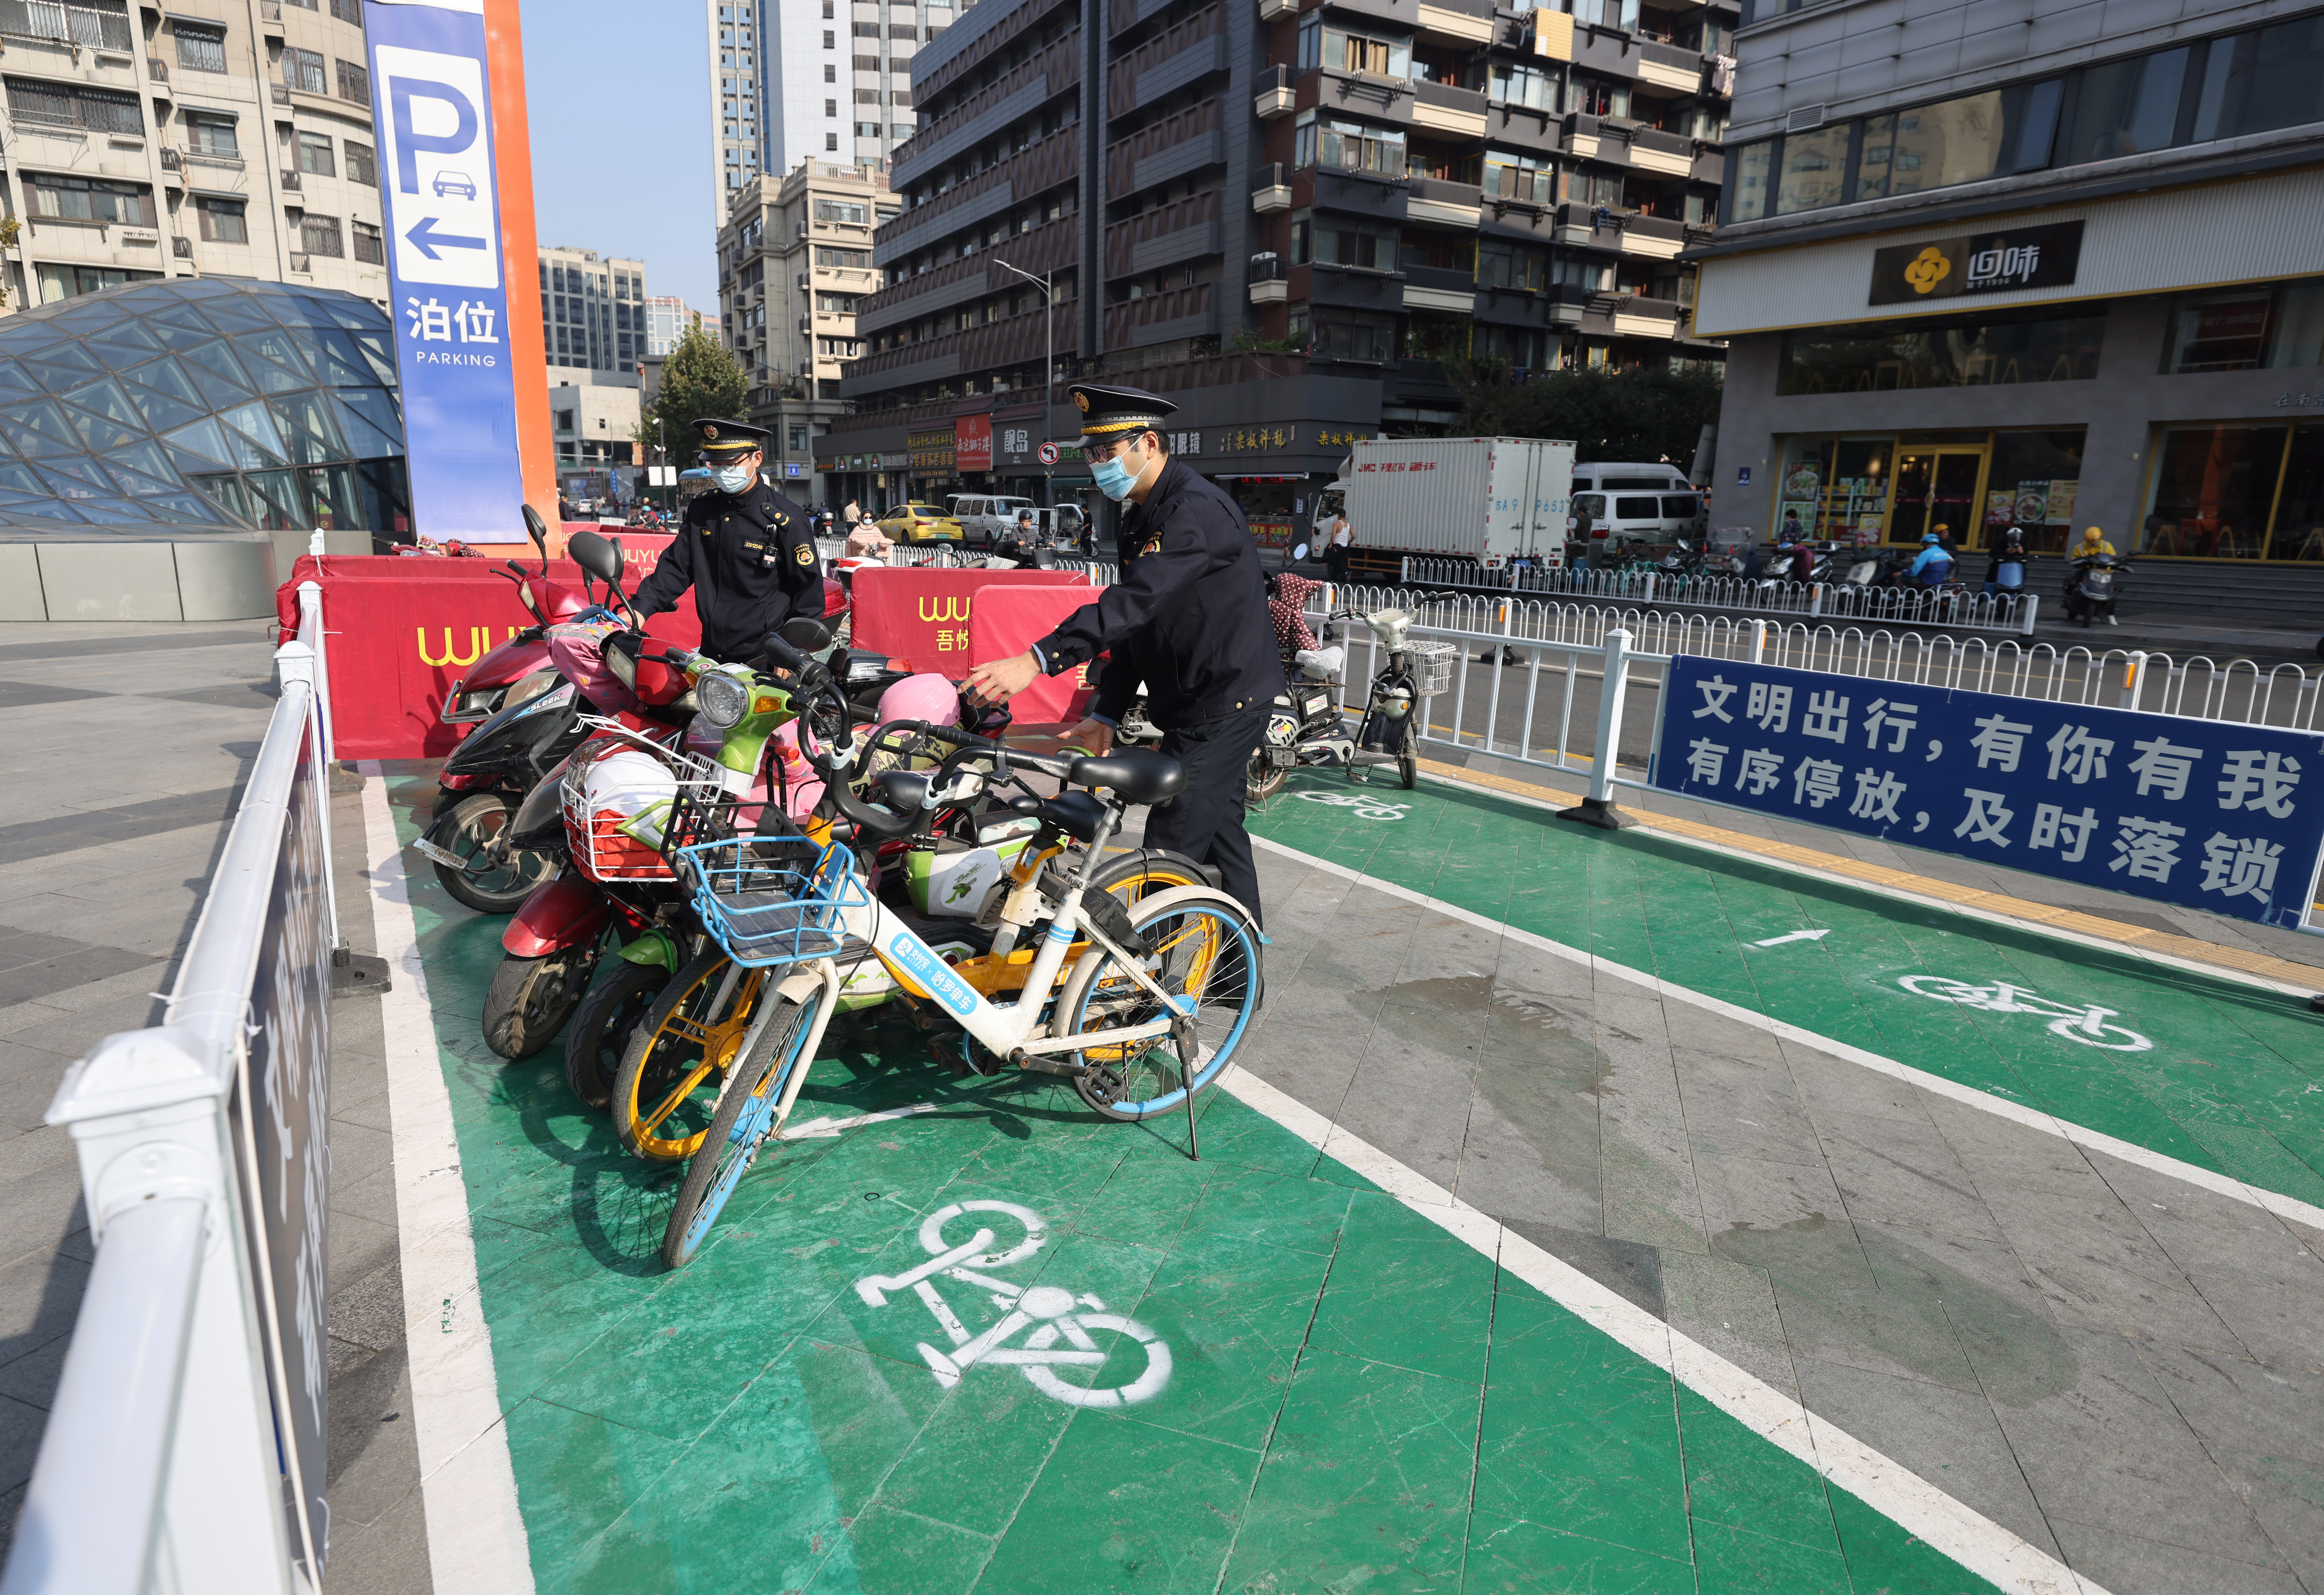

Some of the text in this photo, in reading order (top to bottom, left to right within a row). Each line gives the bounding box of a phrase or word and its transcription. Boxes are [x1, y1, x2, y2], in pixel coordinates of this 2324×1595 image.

[389, 75, 477, 195] P
[1967, 245, 2041, 283] 回味
[405, 296, 499, 344] 泊位
[416, 351, 495, 367] PARKING
[1004, 429, 1028, 453] 靓岛
[914, 451, 953, 466] 老潘家老卤面
[1358, 462, 1437, 472] JMC 千里江铃 品质卡车
[530, 692, 562, 712] SLEEK
[1309, 702, 1326, 711] PINSHENG
[1692, 674, 2302, 820] 文明出行，有你有我
[1685, 736, 2285, 905] 有序停放，及时落锁
[906, 957, 924, 972] ALIPAY
[909, 948, 930, 969] 支付宝
[931, 970, 972, 1010] 哈罗单车
